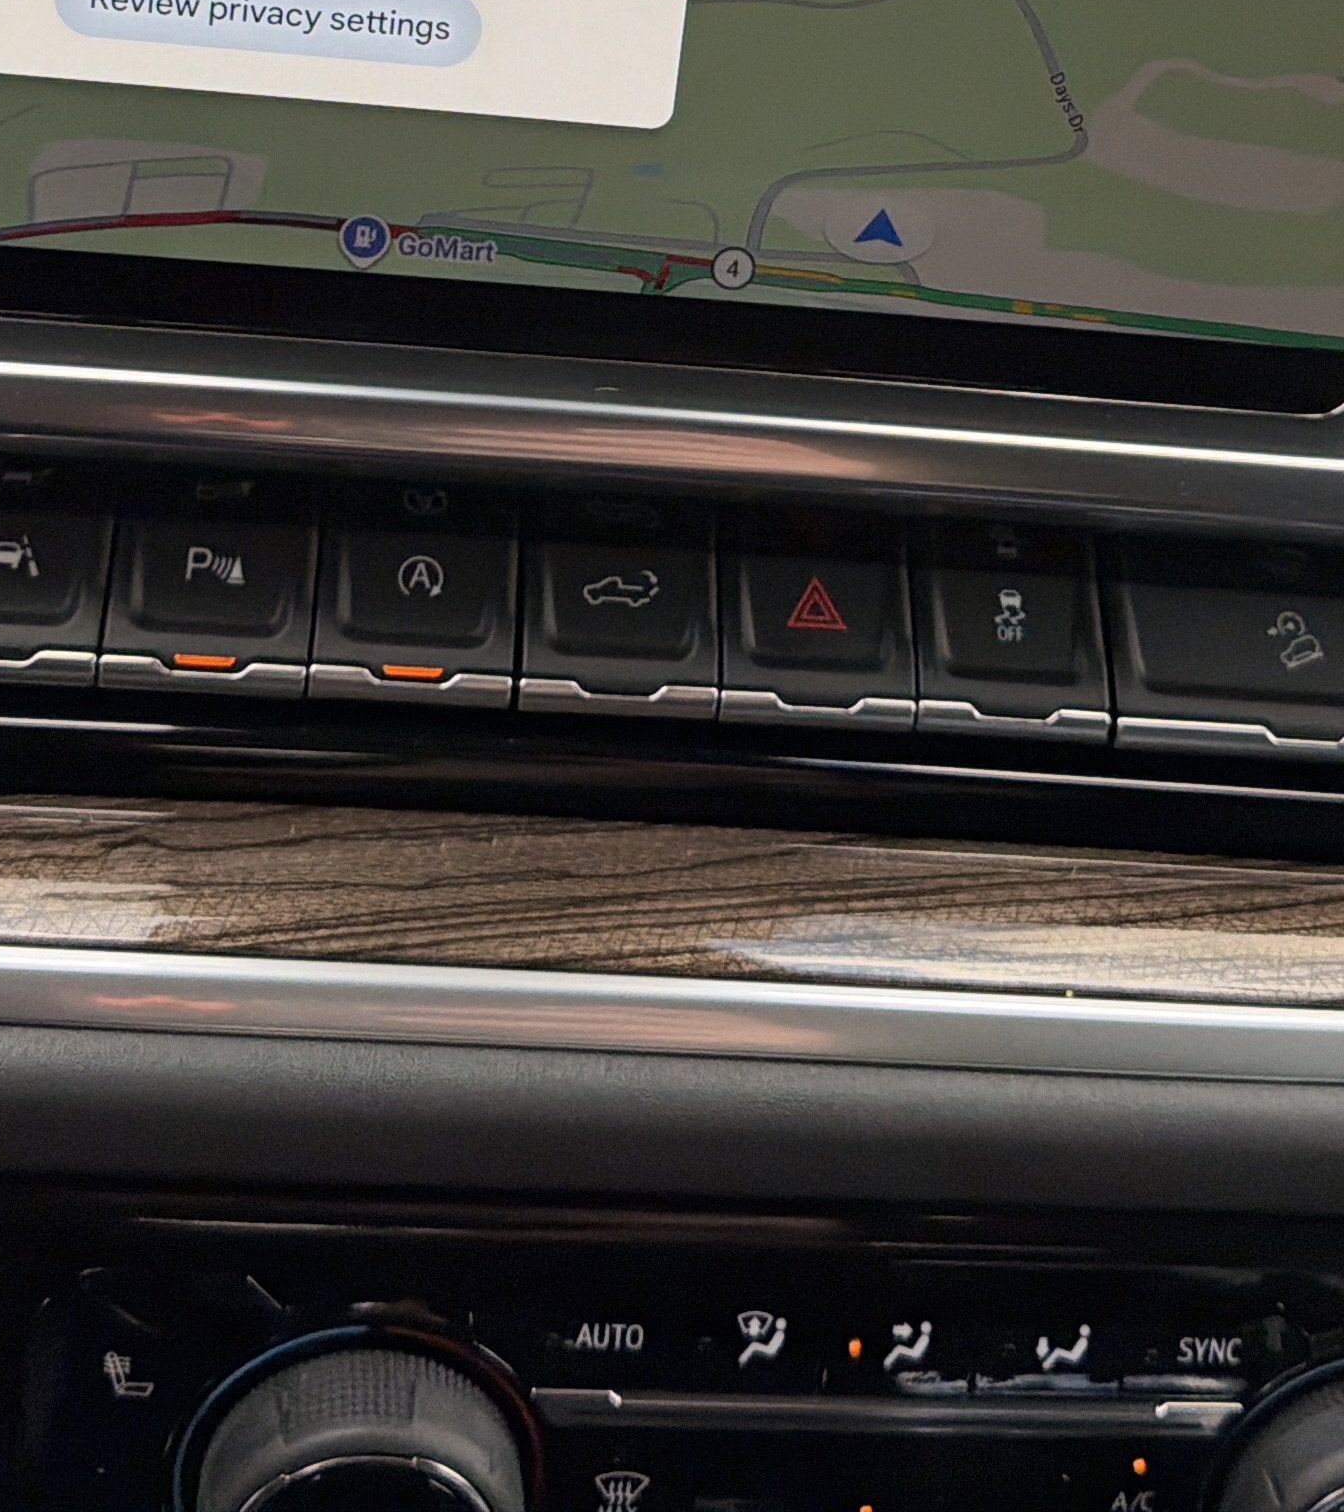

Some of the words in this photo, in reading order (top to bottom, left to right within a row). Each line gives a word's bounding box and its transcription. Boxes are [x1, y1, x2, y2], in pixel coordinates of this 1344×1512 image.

[329, 5, 451, 44] settings
[1050, 72, 1074, 113] Days
[1068, 114, 1084, 133] Dr
[398, 233, 495, 262] GoMart
[726, 259, 739, 278] 4
[997, 625, 1023, 642] OFF
[575, 1323, 644, 1350] AUTO
[1178, 1336, 1243, 1364] SYNC
[1111, 1491, 1155, 1512] A/C
